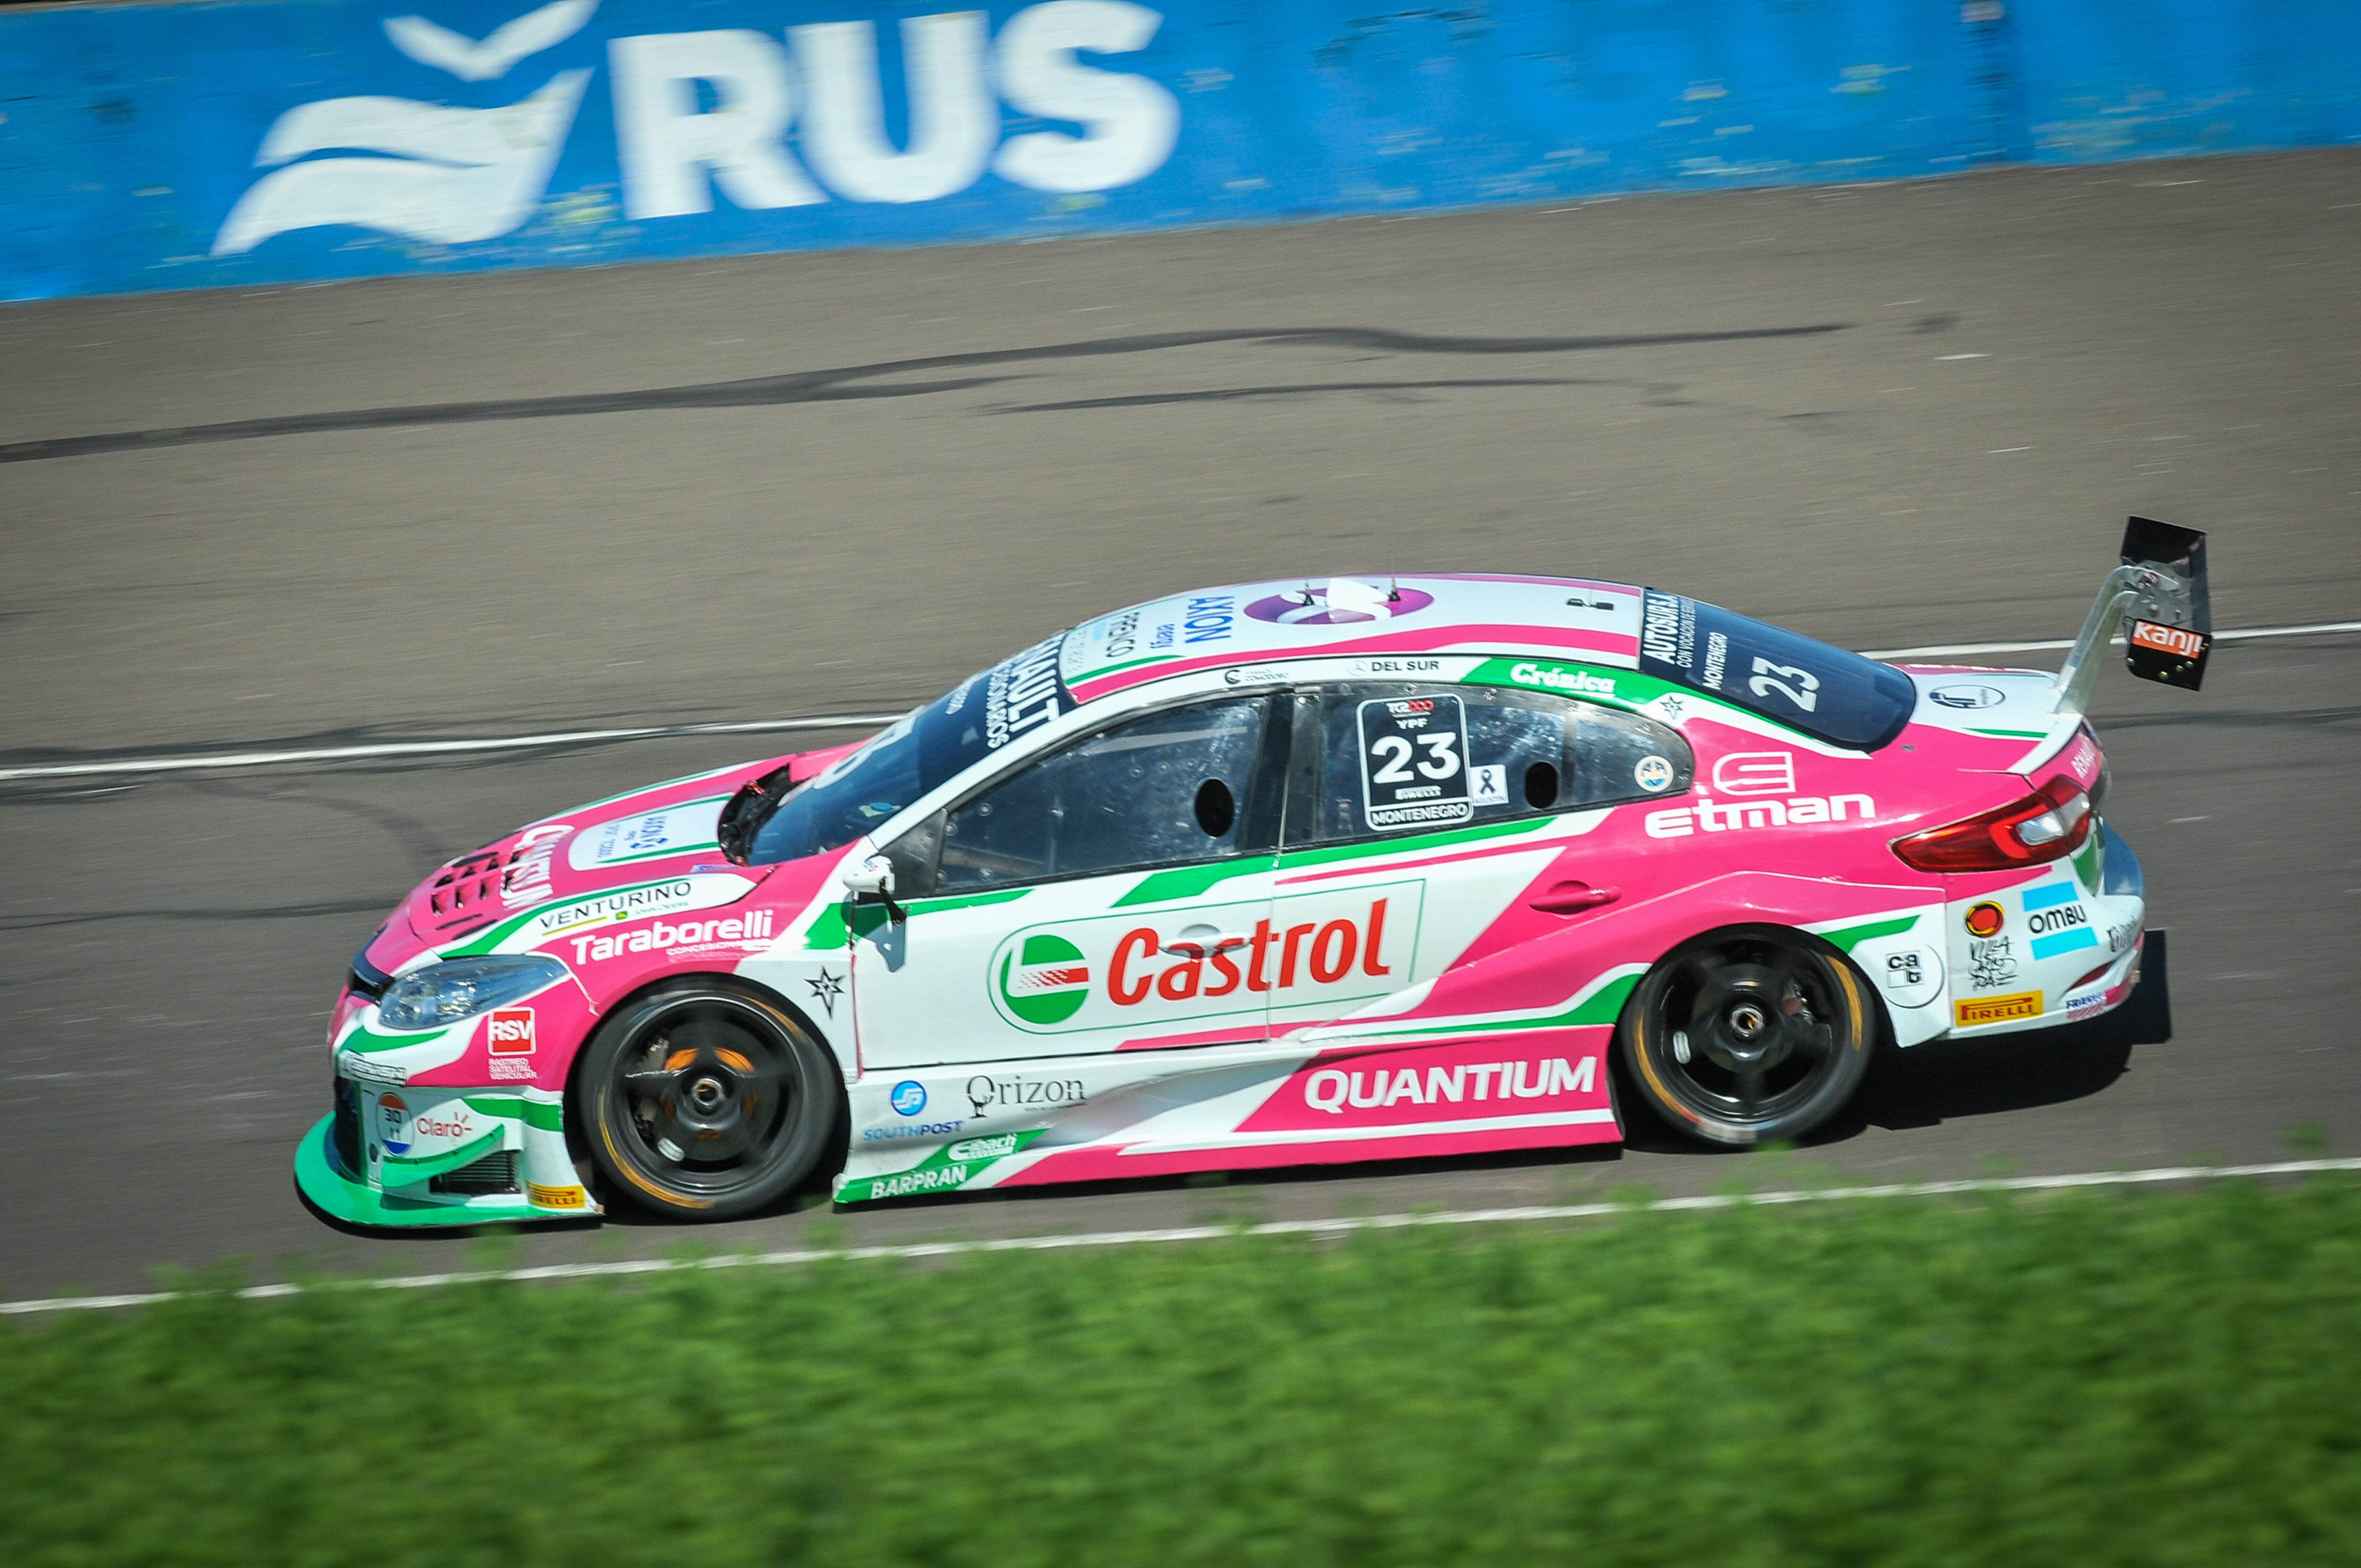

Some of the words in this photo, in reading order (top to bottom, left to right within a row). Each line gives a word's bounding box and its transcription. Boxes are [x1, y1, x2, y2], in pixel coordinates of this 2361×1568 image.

[607, 0, 1180, 220] RUS
[1184, 596, 1235, 644] AXION
[1642, 604, 1679, 665] AUTOSUR
[2132, 622, 2203, 655] kanji
[1371, 661, 1402, 671] DEL
[1407, 661, 1439, 670] SUR
[1676, 650, 1693, 668] CON
[1702, 632, 1728, 690] MONTENEGRO
[1510, 663, 1616, 692] Crónica
[1749, 656, 1820, 712] 23
[1395, 718, 1427, 729] YPF
[1371, 732, 1461, 784] 23
[1394, 785, 1442, 800] PIRELLI
[1372, 803, 1468, 825] MONTENEGRO
[539, 882, 691, 929] VENTURINO
[569, 909, 773, 966] Taraborelli
[1107, 898, 1390, 1006] Castrol
[1961, 996, 2033, 1022] PIRELLI
[490, 1019, 534, 1041] RSV
[966, 1075, 1087, 1118] Orizon
[1305, 1056, 1597, 1114] QUANTIUM
[416, 1118, 463, 1138] Claro
[863, 1120, 963, 1141] SOUTHPOST
[871, 1164, 968, 1200] BARPRAN
